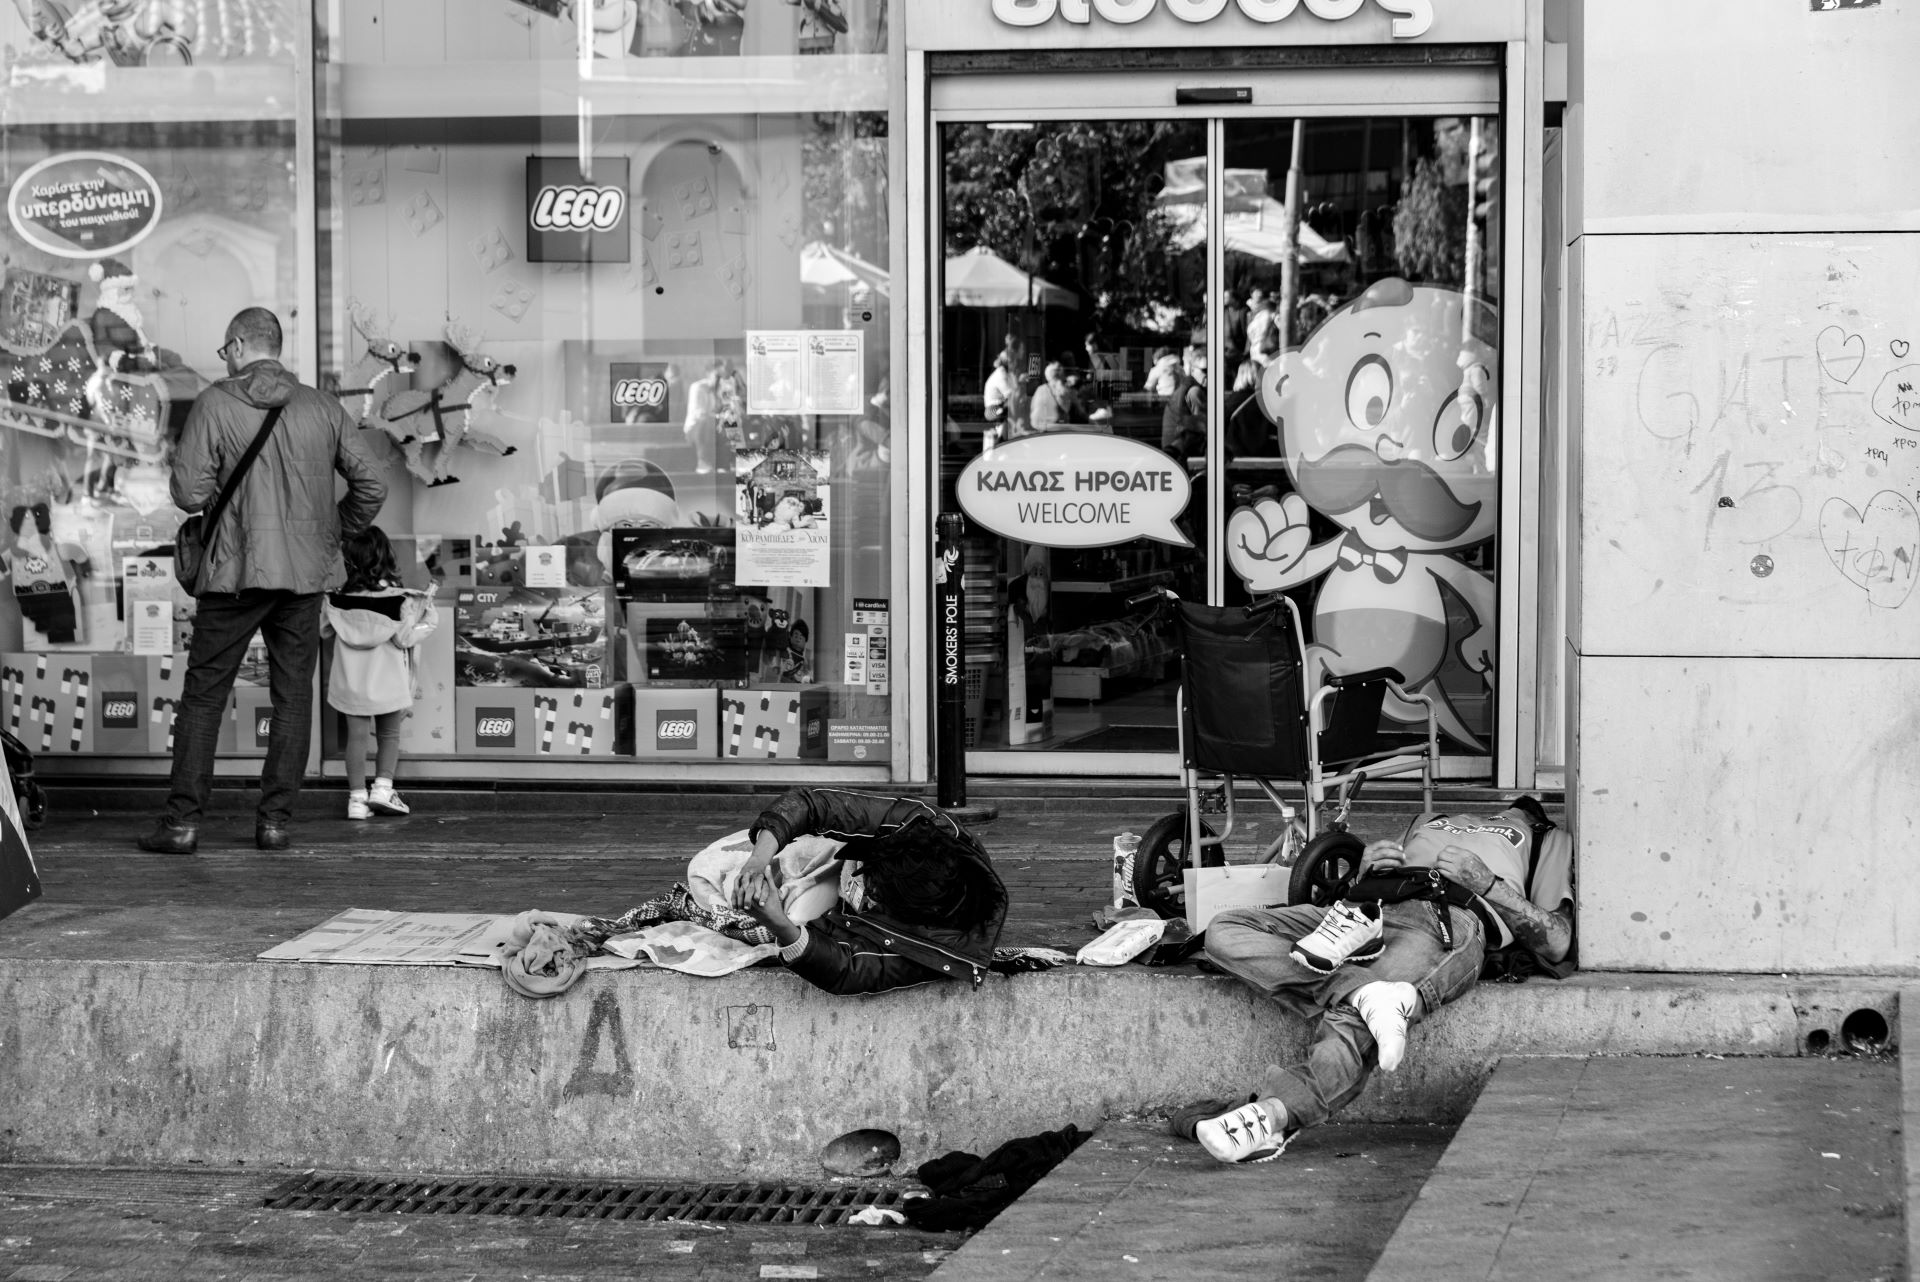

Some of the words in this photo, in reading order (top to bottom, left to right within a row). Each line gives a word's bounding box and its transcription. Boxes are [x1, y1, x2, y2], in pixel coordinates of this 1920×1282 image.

[32, 181, 81, 198] Χαρίστε
[84, 179, 105, 192] την
[20, 188, 150, 219] υπερδύναμη
[532, 186, 624, 231] LEGO
[59, 217, 79, 228] του
[613, 379, 667, 406] LEGO
[977, 470, 1065, 492] ΚΑΛΩΣ
[1075, 470, 1173, 492] ΗΡΘΑΤΕ
[1017, 502, 1131, 524] WELCOME
[477, 593, 498, 602] CITY
[945, 595, 958, 624] POLE
[945, 626, 958, 684] SMOKERS'
[104, 701, 136, 718] LEGO
[477, 718, 514, 736] LEGO
[658, 720, 697, 739] LEGO
